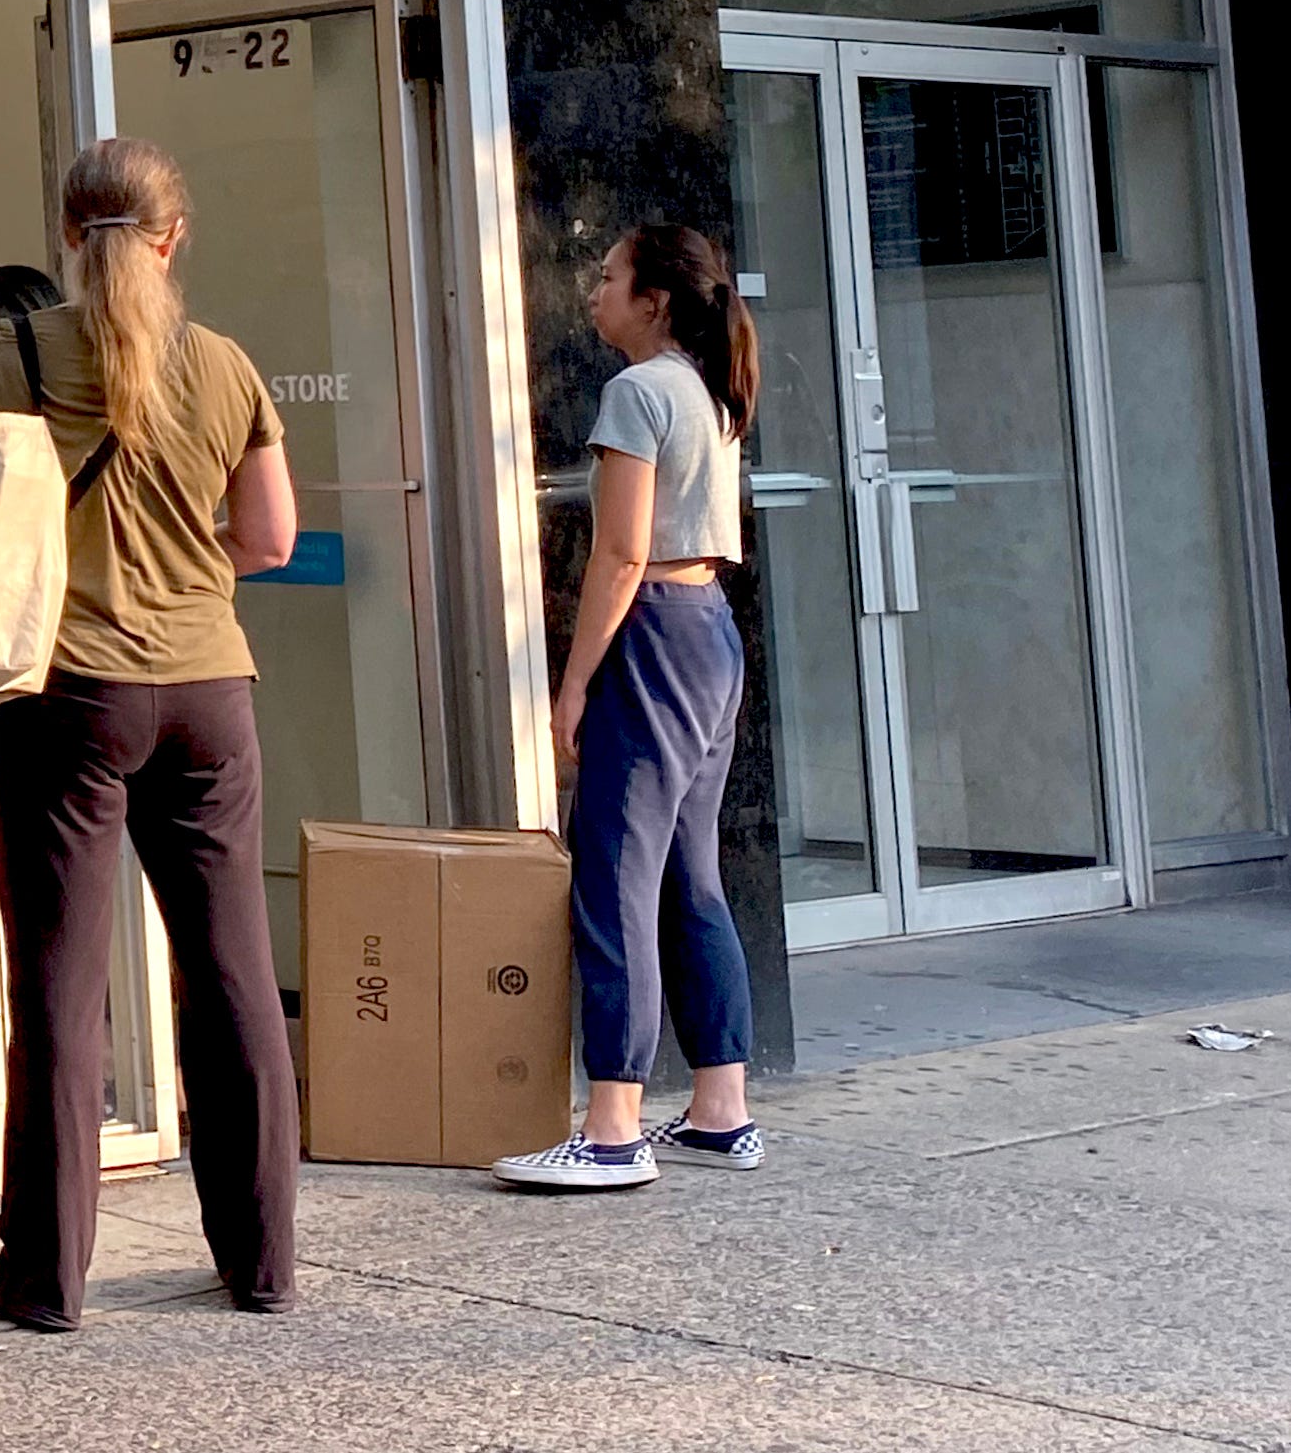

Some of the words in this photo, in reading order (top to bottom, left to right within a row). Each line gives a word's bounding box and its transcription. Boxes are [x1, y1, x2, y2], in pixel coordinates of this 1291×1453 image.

[173, 28, 290, 78] 9-22
[270, 373, 350, 404] STORE
[356, 975, 389, 1023] 2A6
